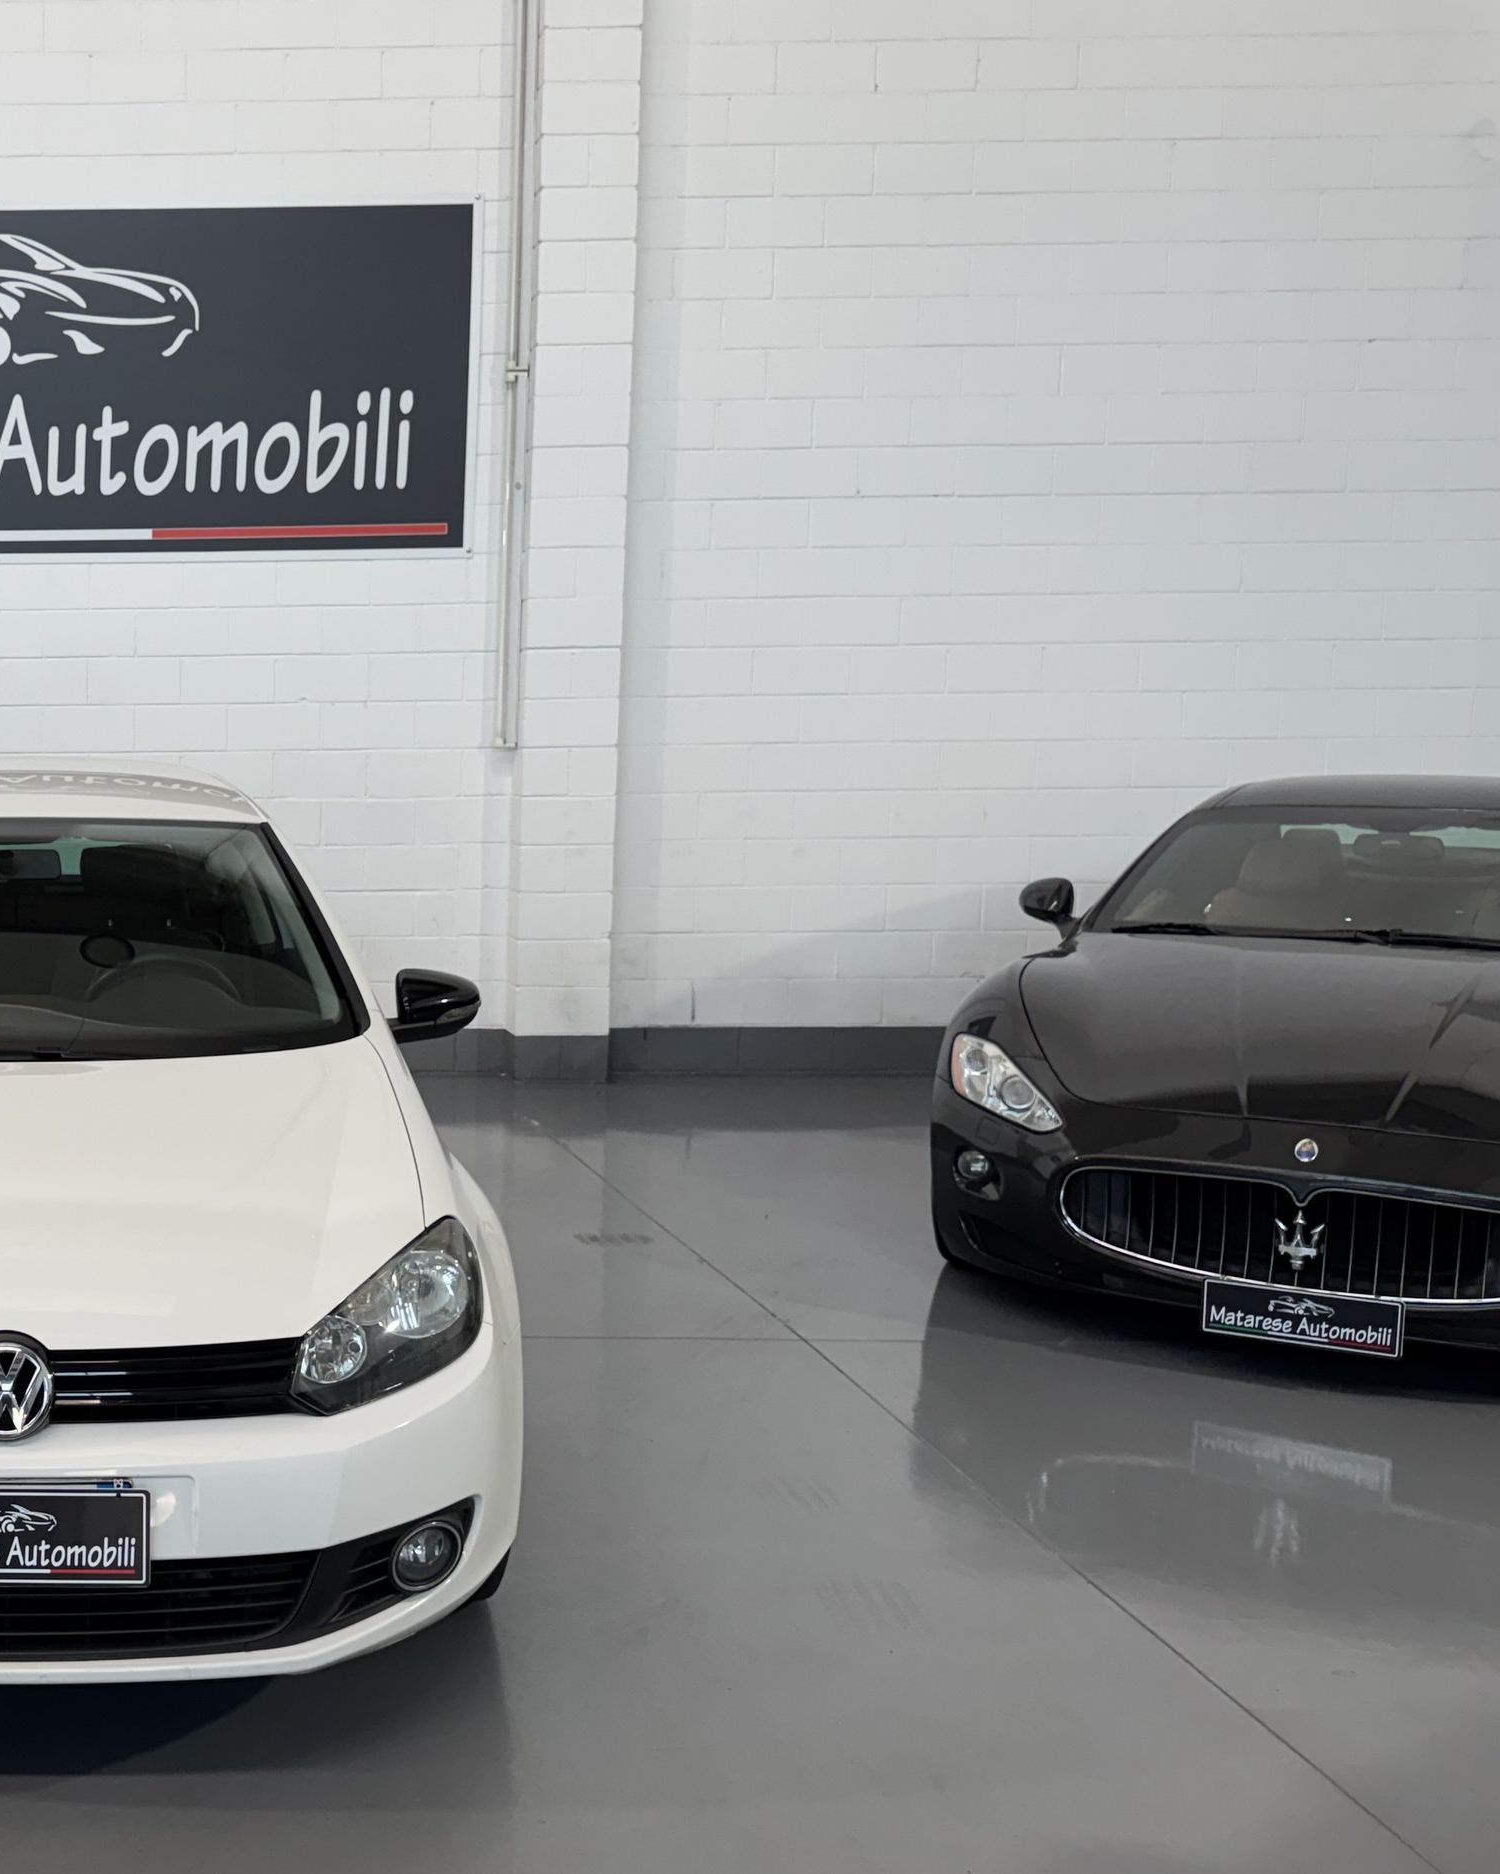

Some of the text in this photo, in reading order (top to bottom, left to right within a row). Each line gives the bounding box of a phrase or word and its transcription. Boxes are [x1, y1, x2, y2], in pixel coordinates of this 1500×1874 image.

[1209, 1304, 1393, 1347] Matarese Automobili
[5, 1535, 137, 1568] Automobili
